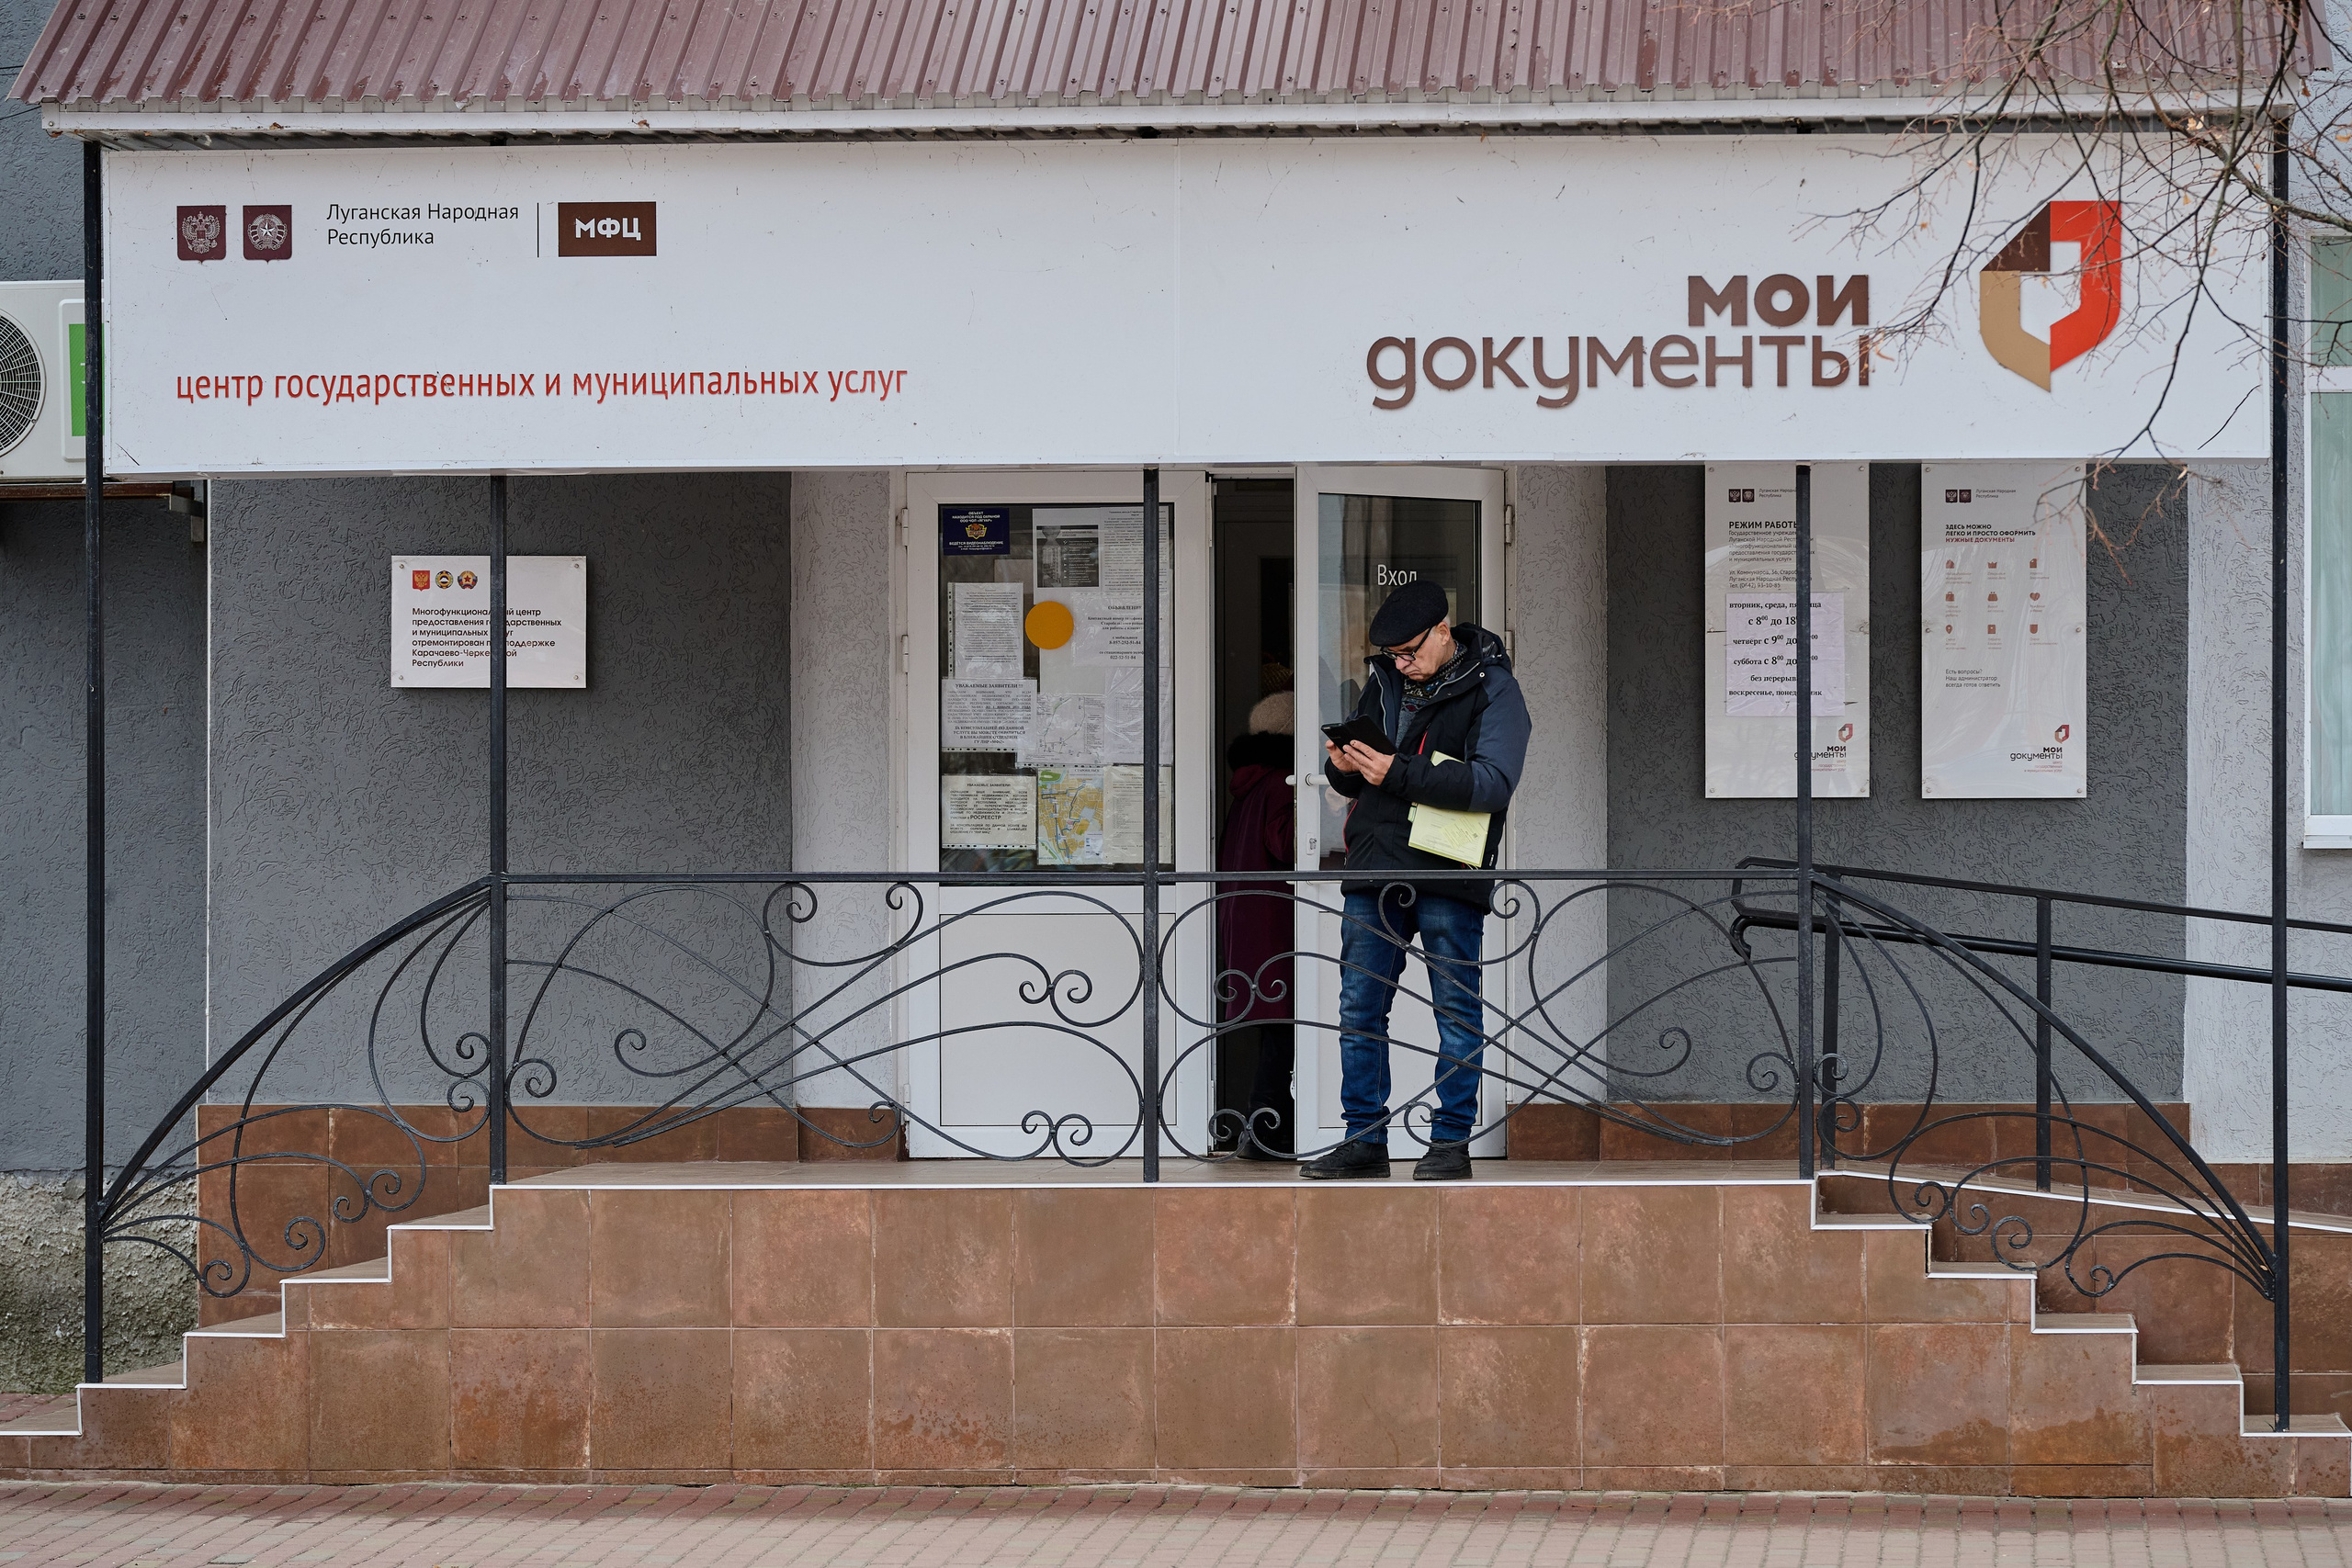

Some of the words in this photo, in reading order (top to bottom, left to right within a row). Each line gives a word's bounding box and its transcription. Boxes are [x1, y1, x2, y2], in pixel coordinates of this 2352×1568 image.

[327, 203, 421, 224] Луганская
[428, 203, 519, 223] Народная
[328, 228, 434, 248] Республика
[575, 217, 641, 241] МФЦ
[1366, 334, 1870, 410] документы
[177, 374, 264, 406] центр
[275, 372, 535, 406] государственных
[545, 372, 561, 396] и
[573, 371, 819, 404] муниципальных
[828, 370, 908, 402] услуг
[516, 608, 541, 617] центр
[2010, 753, 2062, 761] документы
